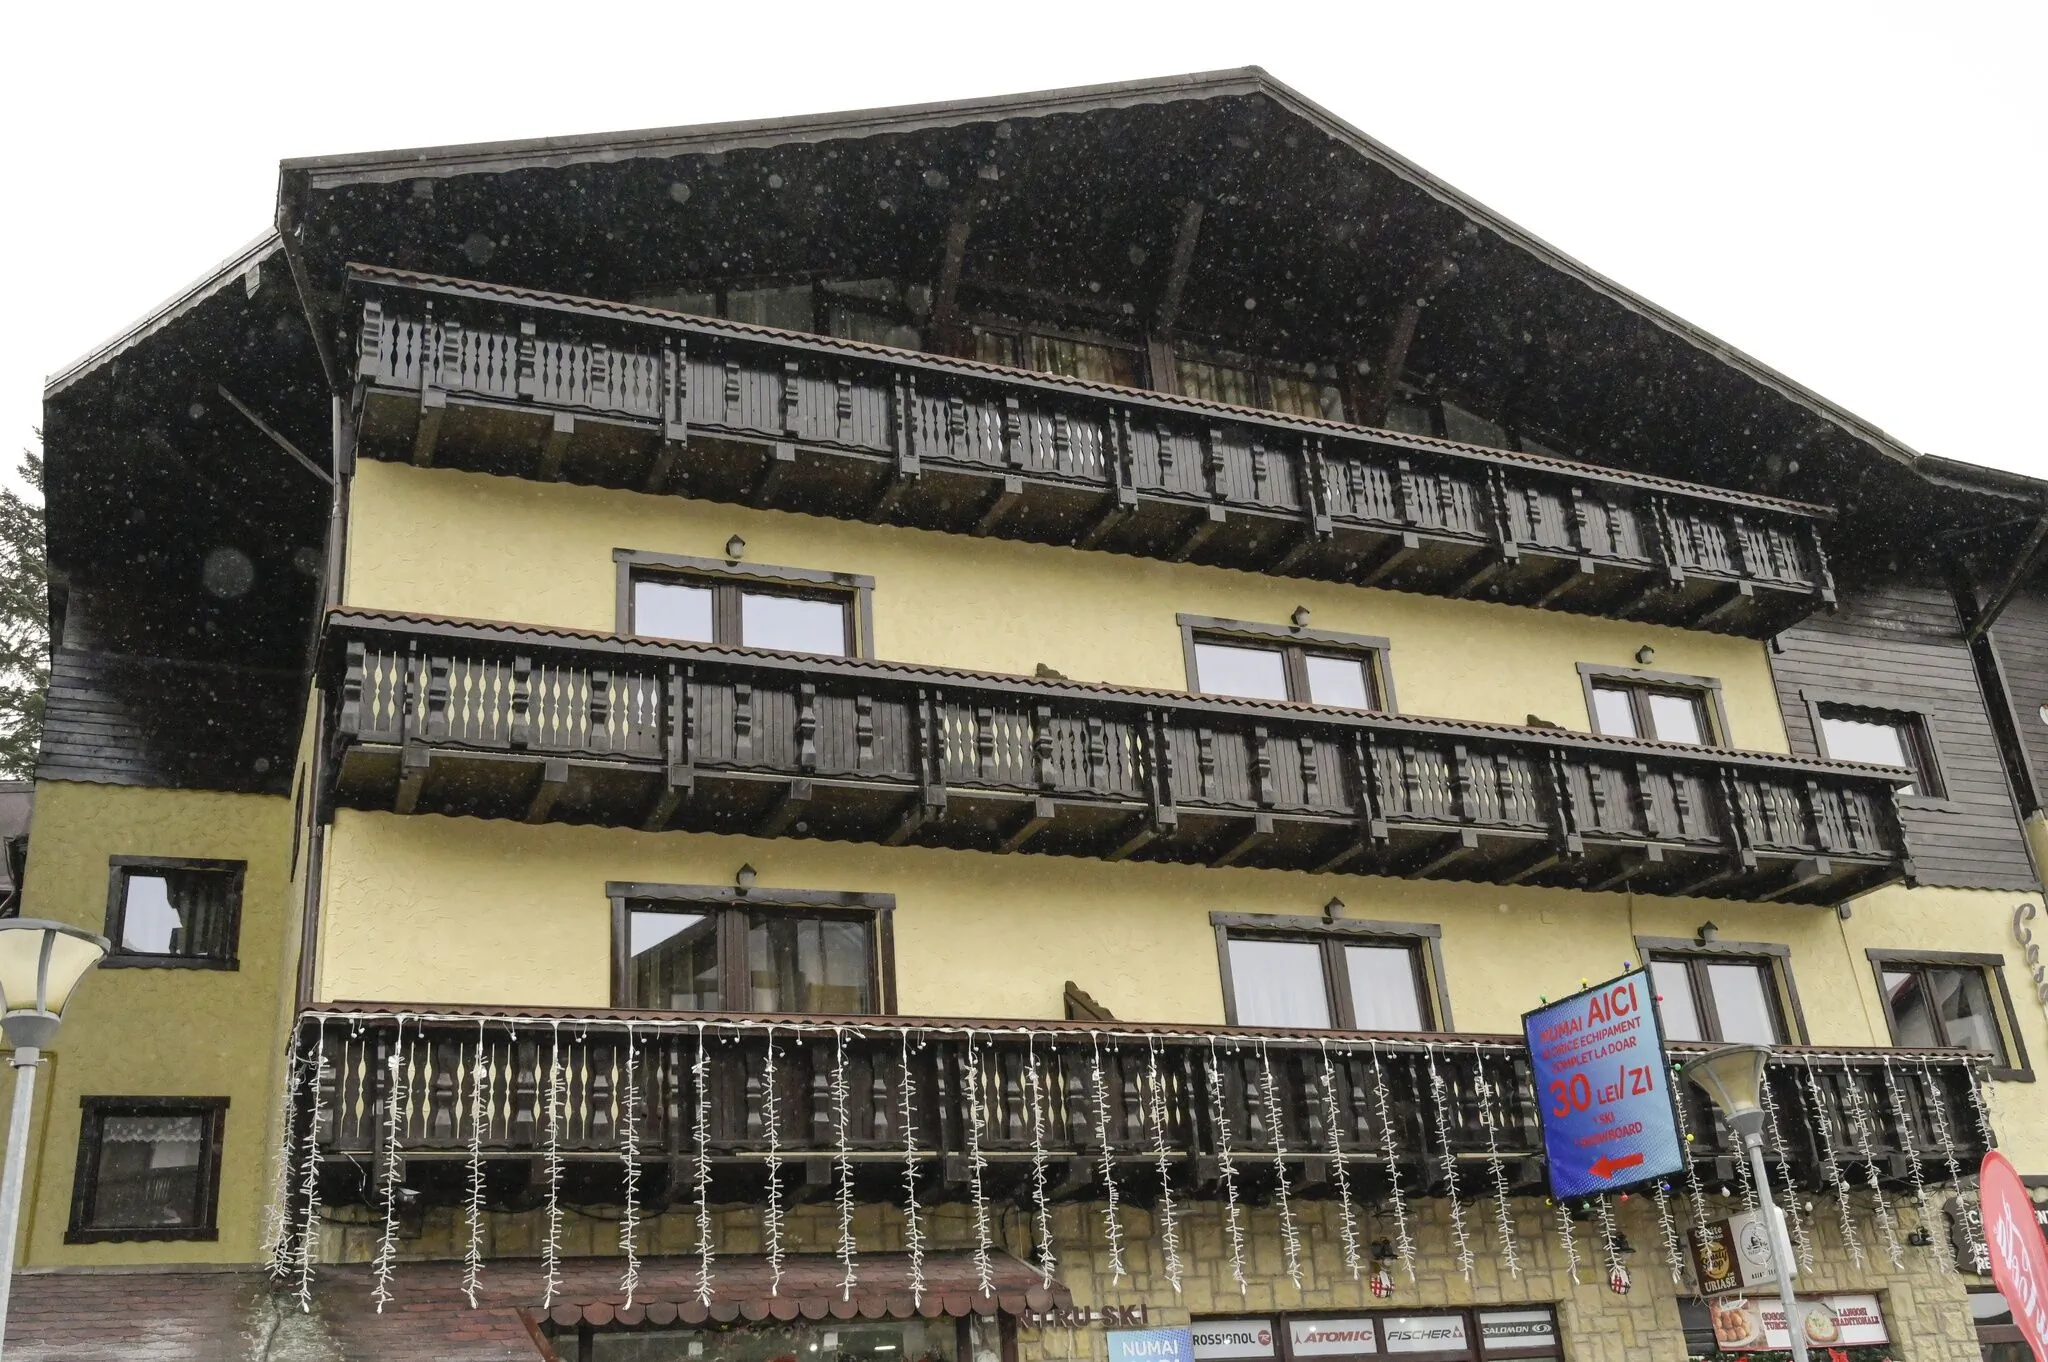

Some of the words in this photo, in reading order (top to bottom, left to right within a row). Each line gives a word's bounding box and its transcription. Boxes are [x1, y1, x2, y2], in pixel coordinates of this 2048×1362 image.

[1588, 982, 1638, 1028] AICI
[1580, 1016, 1641, 1047] ECHIPAMENT
[1594, 1046, 1607, 1059] LA
[1608, 1036, 1637, 1055] DOAR
[1549, 1073, 1592, 1119] 30
[1580, 1121, 1642, 1148] WBOARD
[1101, 1303, 1149, 1328] SKI
[1193, 1332, 1256, 1346] ROSSIGNOL
[1305, 1330, 1373, 1344] ATOMIC
[1387, 1329, 1452, 1341] FISCHER
[1482, 1325, 1529, 1335] SALOMON
[1122, 1340, 1178, 1357] NUMAI
